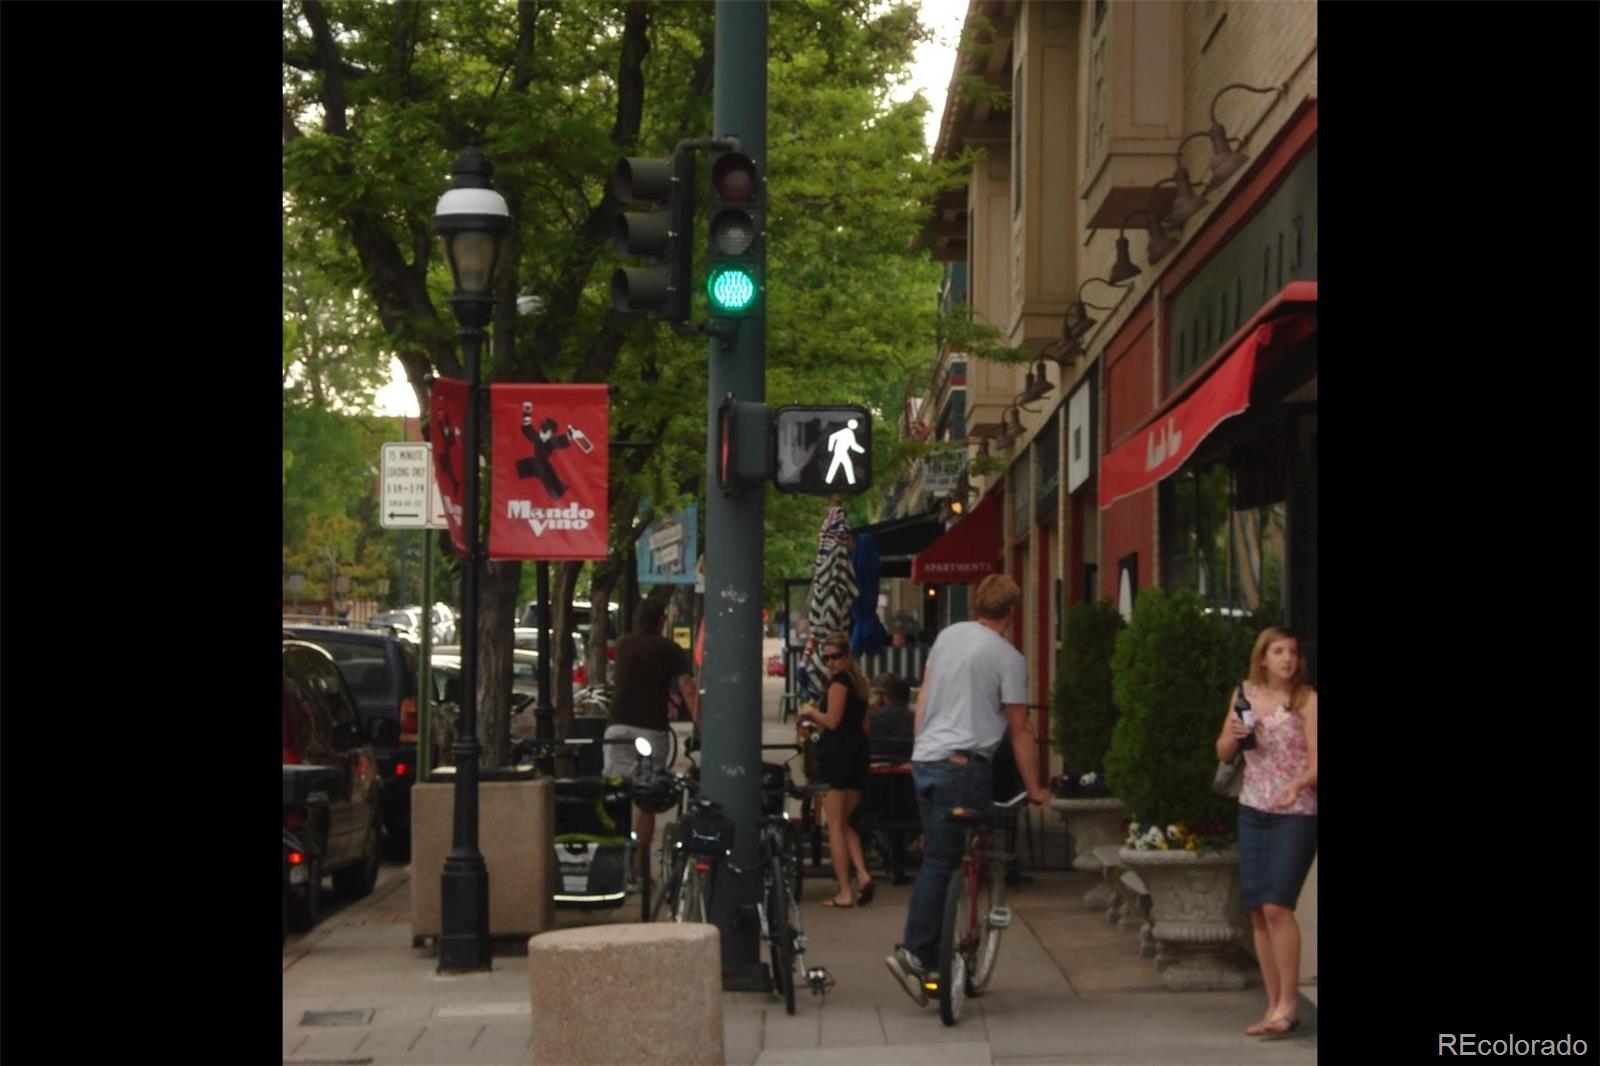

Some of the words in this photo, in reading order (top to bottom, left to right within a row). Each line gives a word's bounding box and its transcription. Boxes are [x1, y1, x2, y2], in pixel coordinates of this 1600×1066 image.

[400, 450, 425, 461] MINUTE
[386, 466, 410, 478] LOADING
[507, 500, 595, 520] Mando
[528, 519, 589, 537] Vino
[924, 562, 992, 573] APARTMENTS
